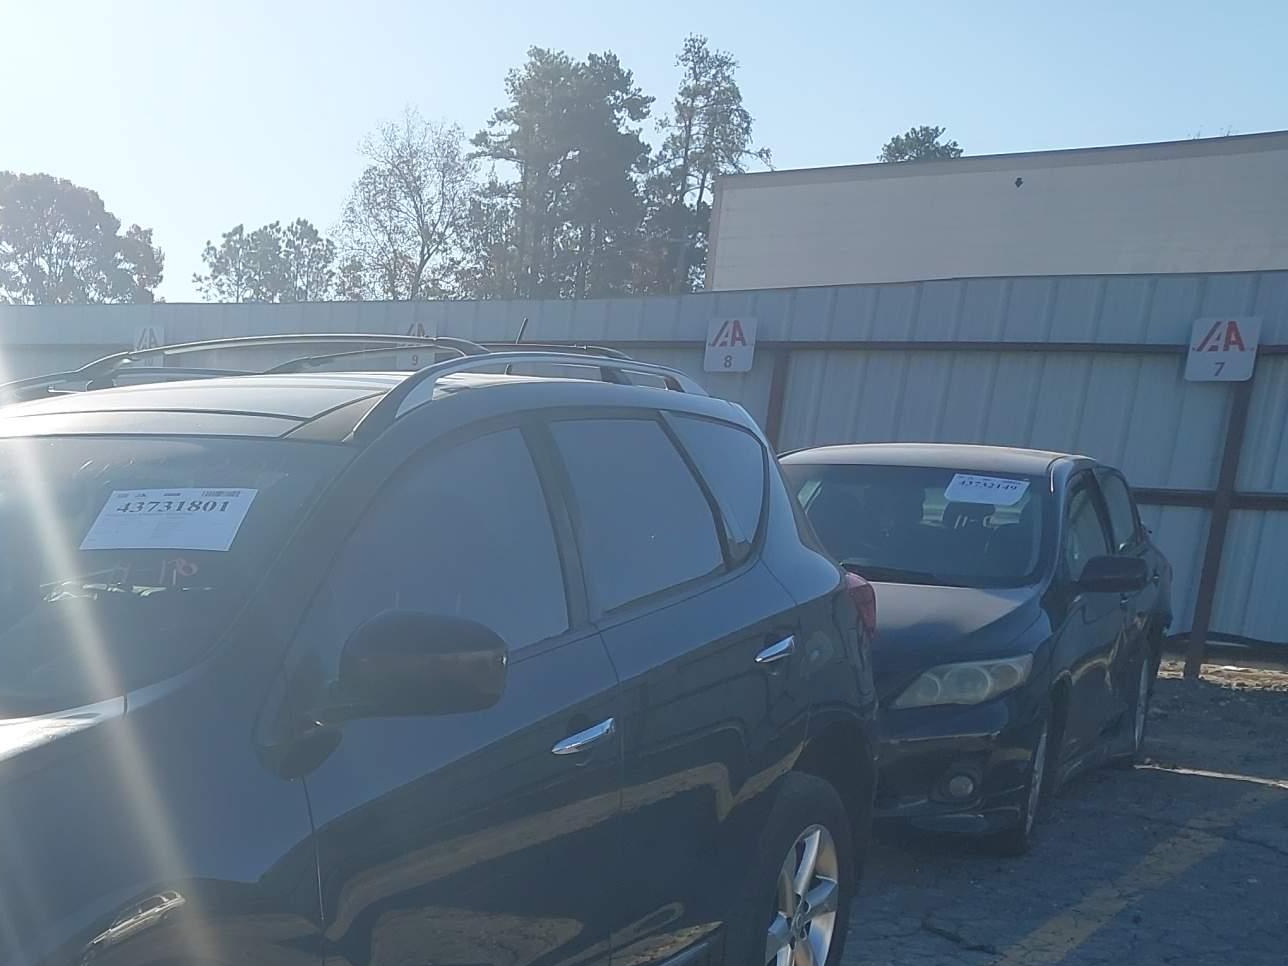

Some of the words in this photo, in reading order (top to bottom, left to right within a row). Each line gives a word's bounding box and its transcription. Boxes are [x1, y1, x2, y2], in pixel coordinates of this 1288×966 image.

[724, 355, 732, 368] 8
[1214, 361, 1225, 376] 7
[116, 500, 231, 513] 43731801
